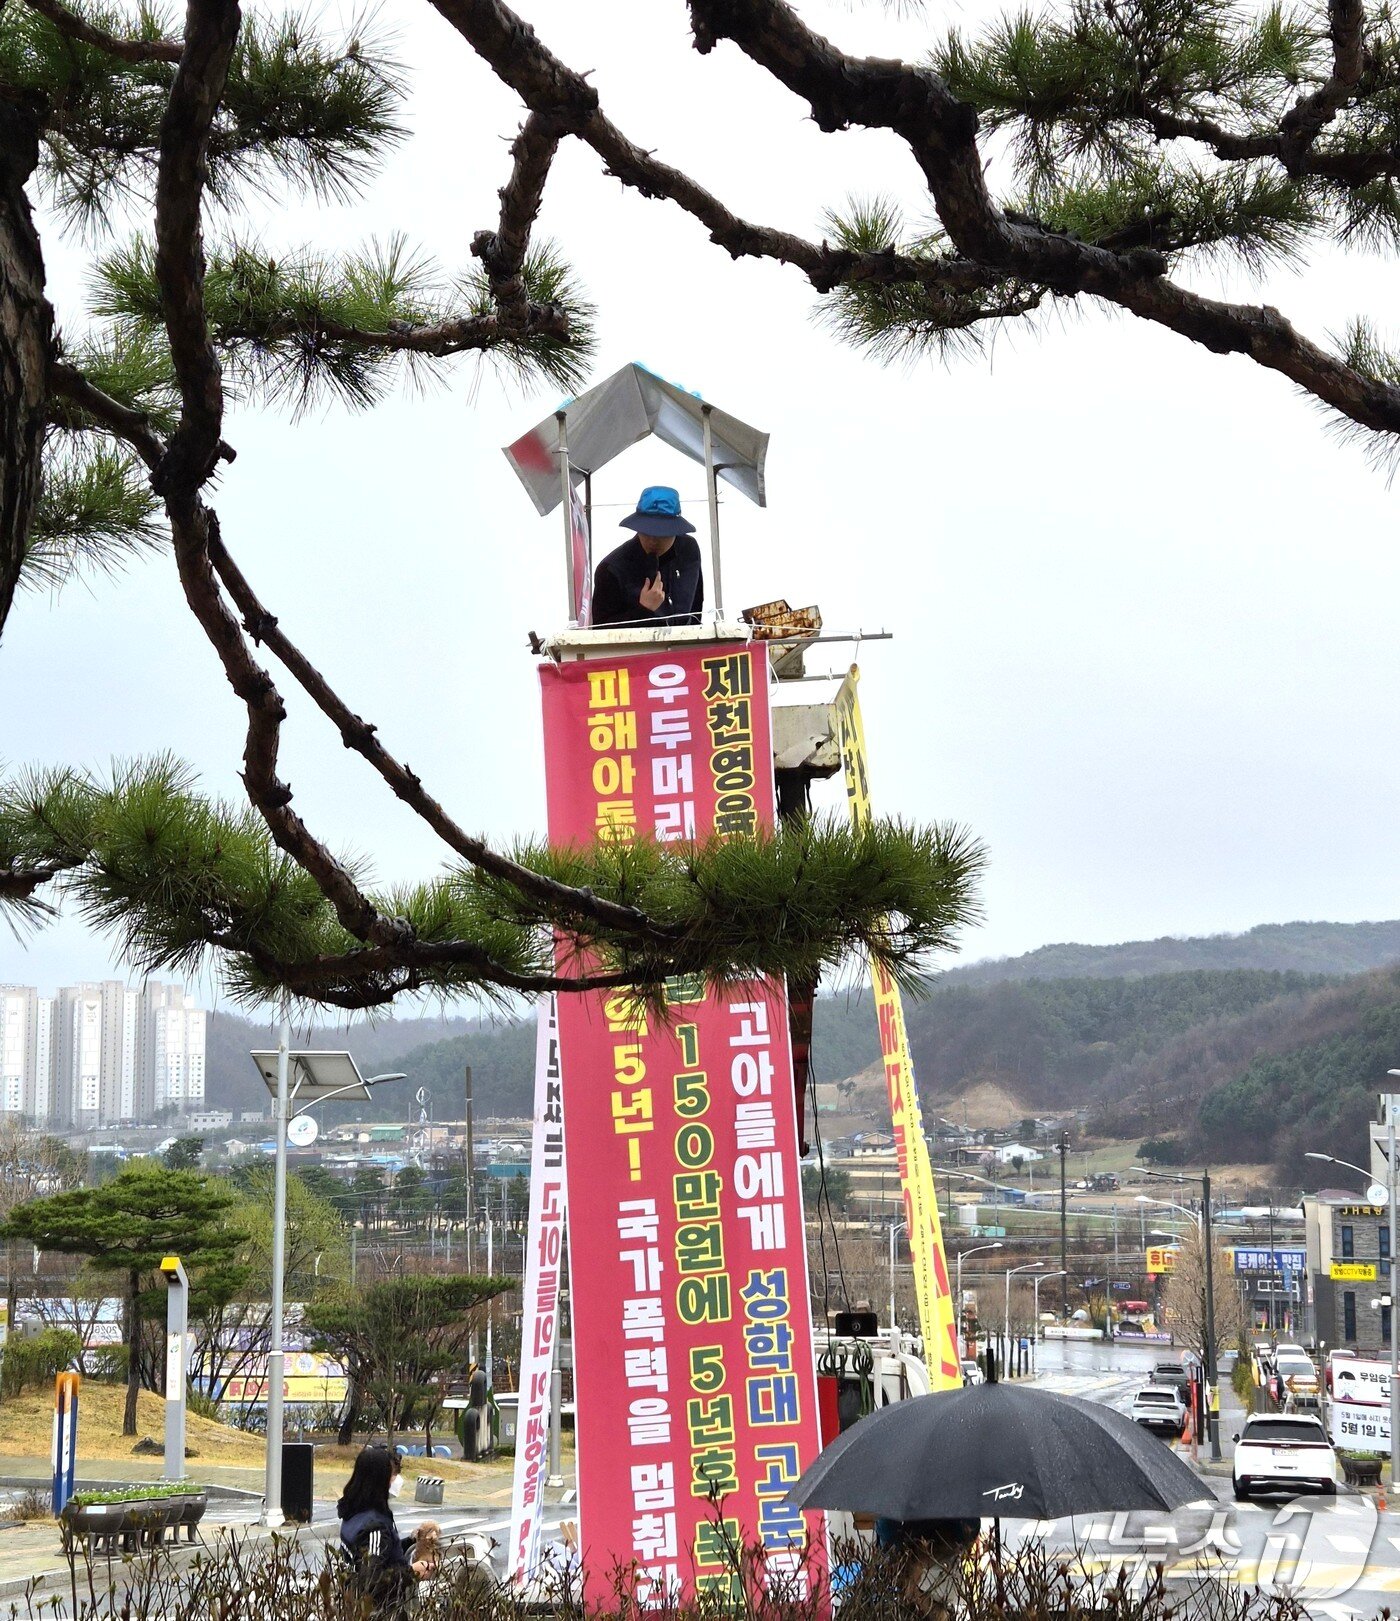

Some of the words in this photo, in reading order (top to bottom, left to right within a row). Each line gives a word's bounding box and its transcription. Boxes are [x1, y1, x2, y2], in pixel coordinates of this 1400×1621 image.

[673, 1022, 733, 1325] 150만원에
[729, 1001, 786, 1251] 고아들에게
[617, 1198, 672, 1446] 국가폭력을
[687, 1345, 740, 1498] 5년후
[739, 1268, 802, 1428] 성학대
[1341, 1422, 1358, 1435] 5월
[1361, 1424, 1376, 1437] 1일
